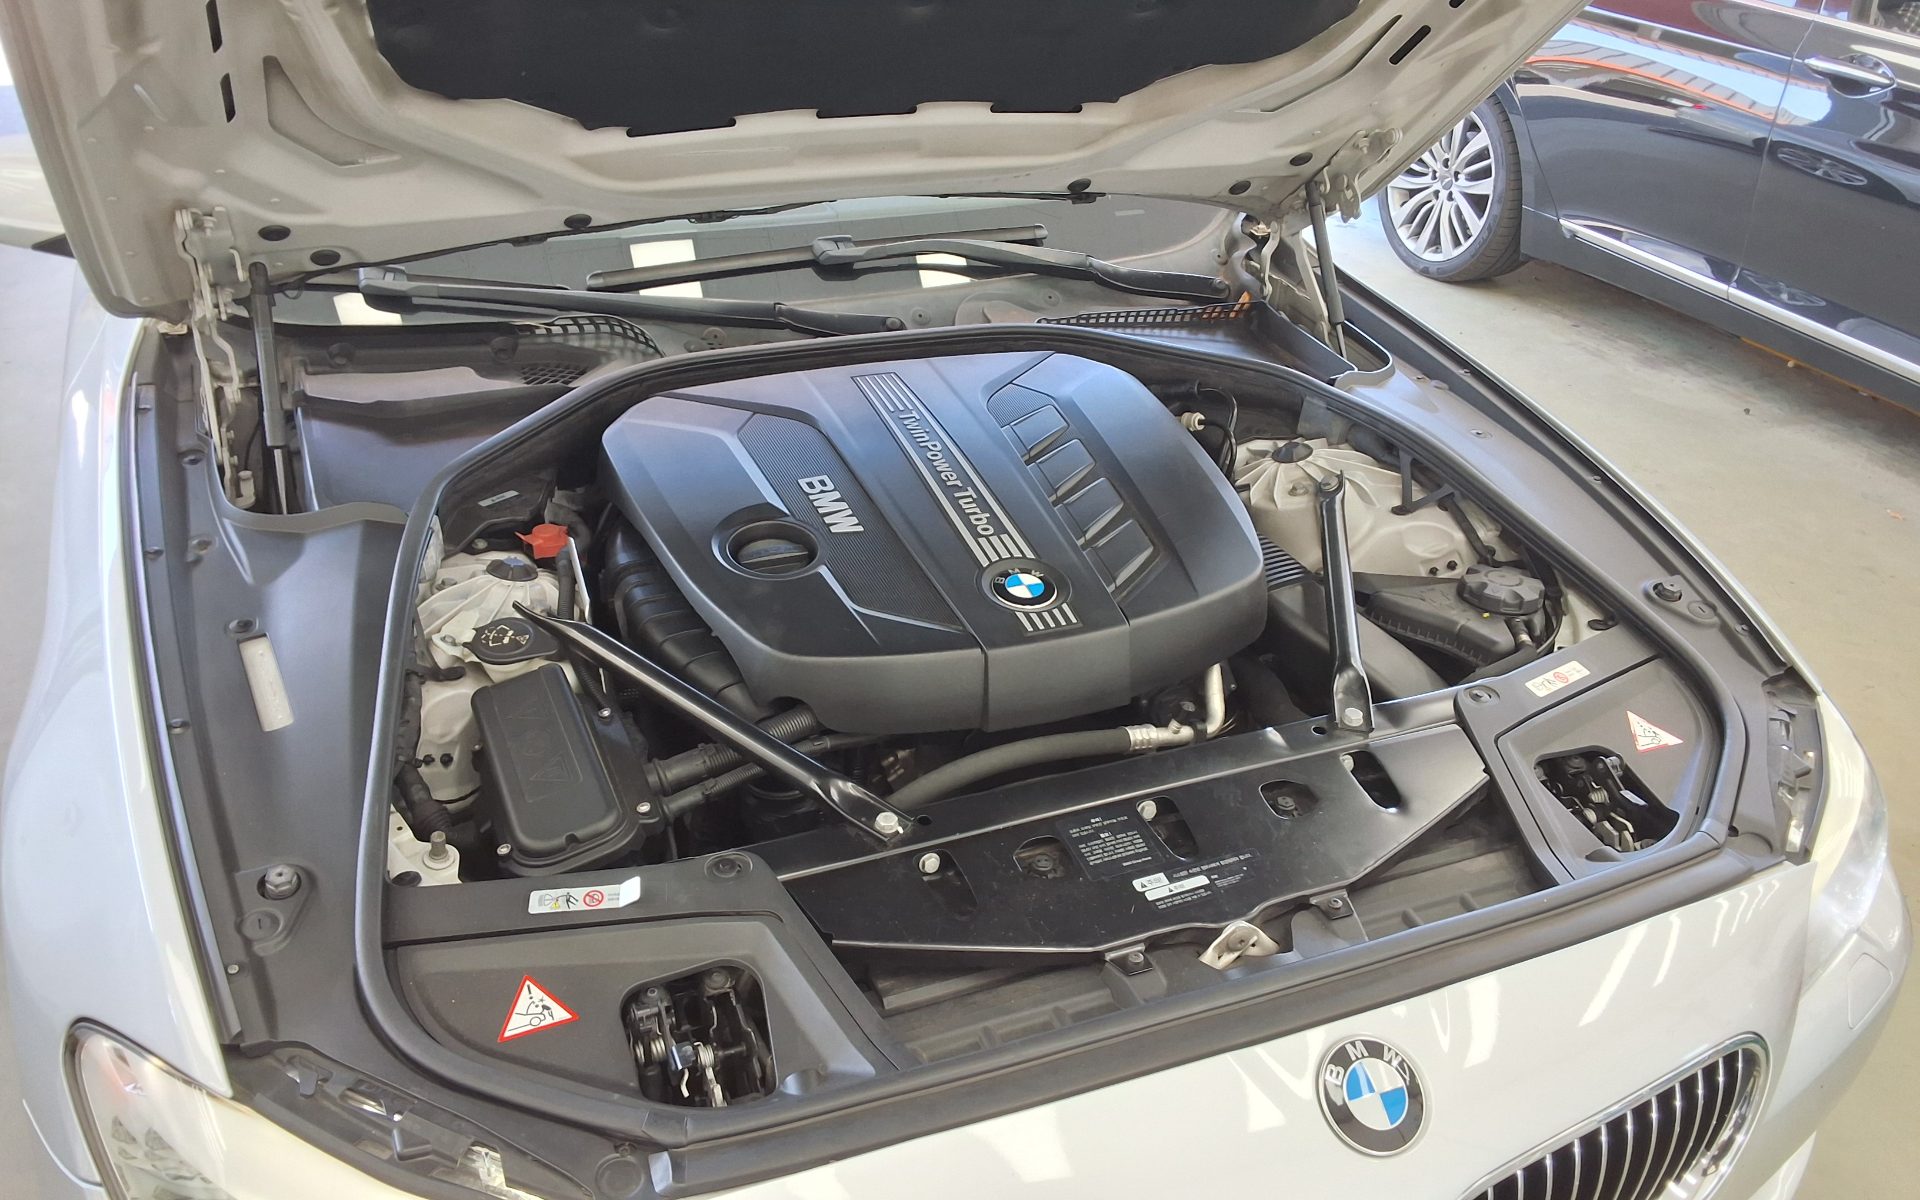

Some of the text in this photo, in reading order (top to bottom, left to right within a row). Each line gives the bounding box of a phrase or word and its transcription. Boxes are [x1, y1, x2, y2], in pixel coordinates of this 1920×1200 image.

[898, 409, 994, 537] TwinPower Turbo
[797, 474, 865, 534] BMW
[994, 567, 1045, 584] BMW
[1325, 1040, 1410, 1086] BMW
